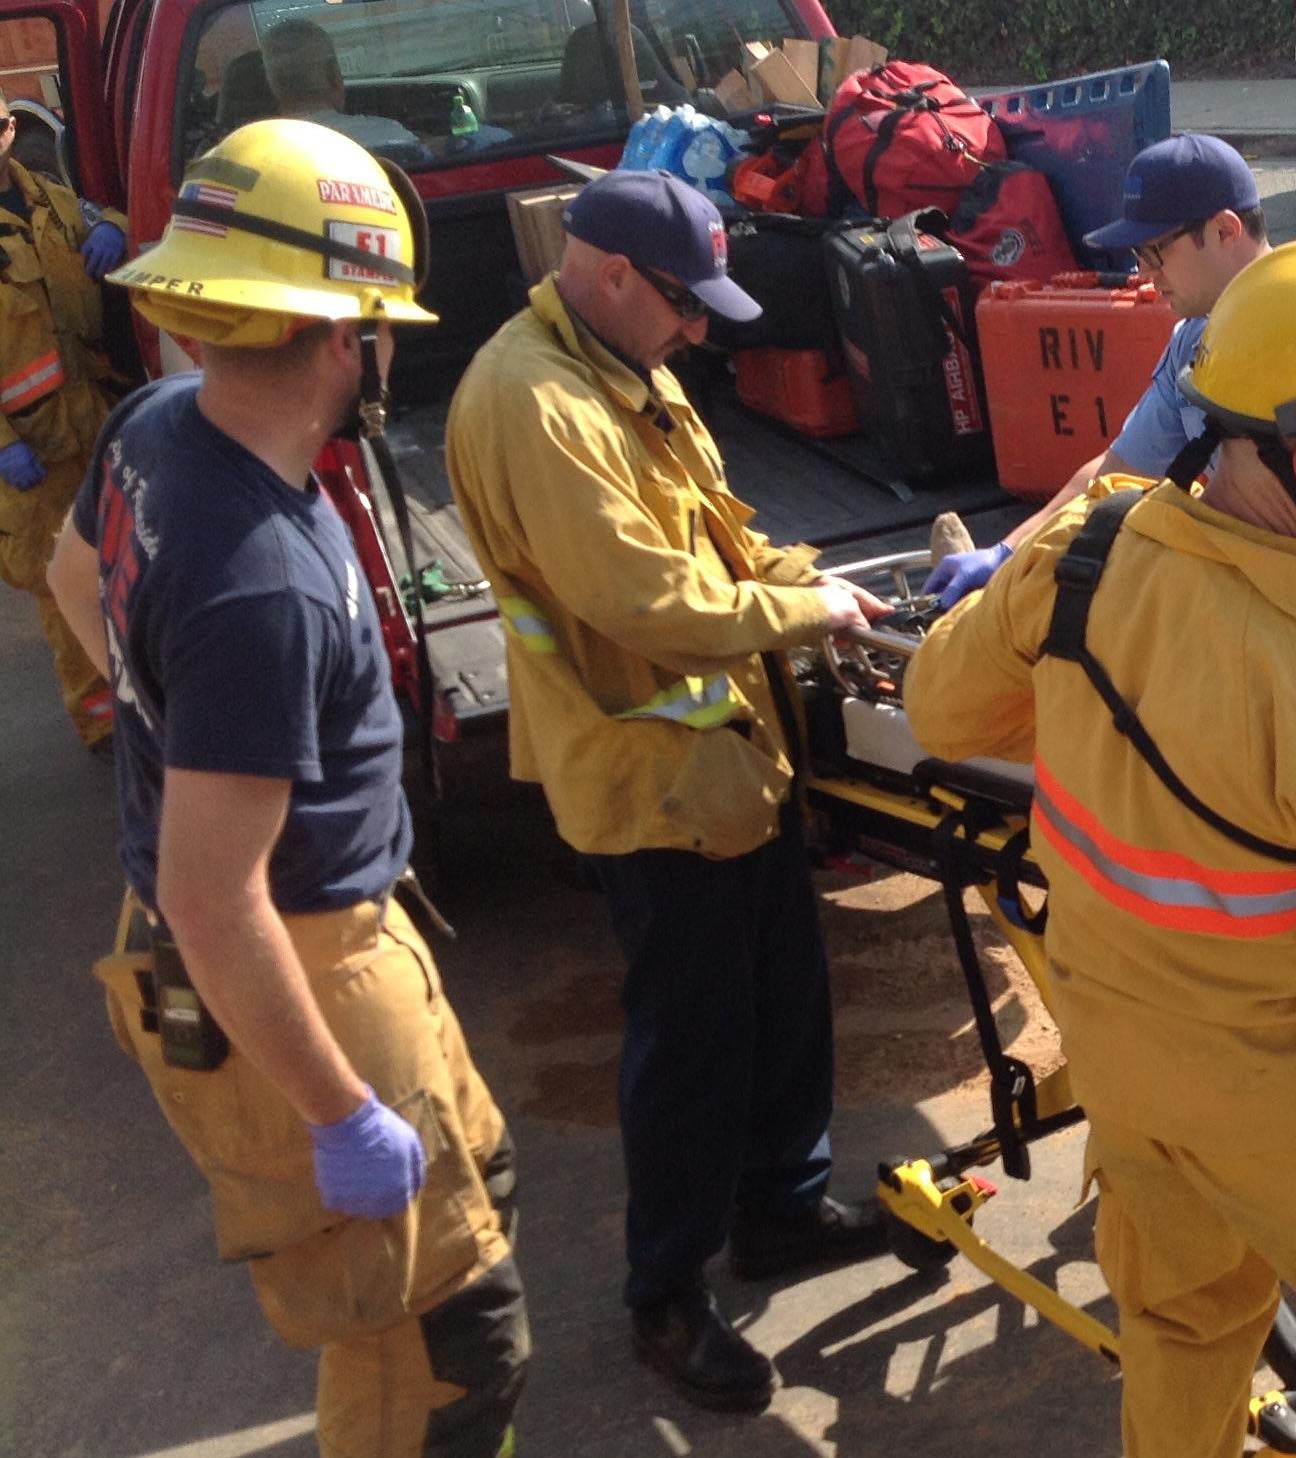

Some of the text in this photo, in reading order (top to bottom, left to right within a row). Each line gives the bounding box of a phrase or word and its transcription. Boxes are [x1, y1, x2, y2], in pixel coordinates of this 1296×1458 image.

[341, 263, 396, 282] STAM
[1039, 327, 1105, 371] RIV
[954, 409, 971, 435] HP
